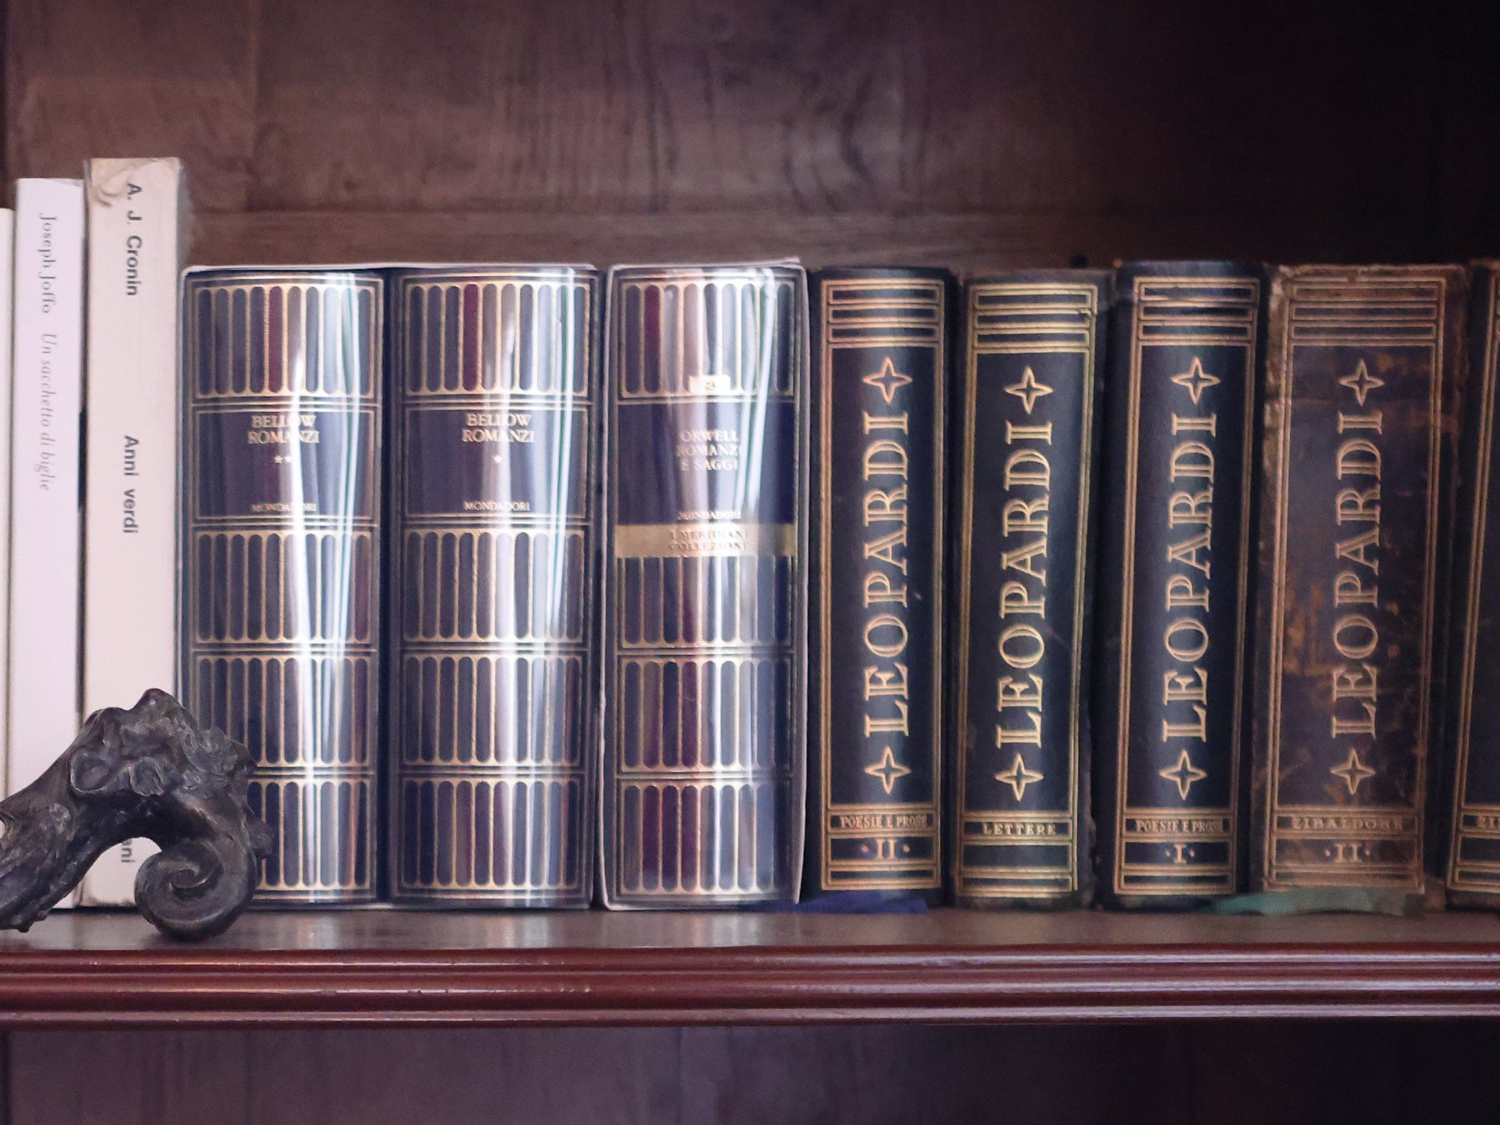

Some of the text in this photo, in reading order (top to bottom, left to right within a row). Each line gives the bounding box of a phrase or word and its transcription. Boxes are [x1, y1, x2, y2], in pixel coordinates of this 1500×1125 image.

[38, 212, 57, 270] Joseph
[127, 235, 143, 296] Cronin
[37, 272, 57, 315] Joffo
[40, 359, 57, 428] sacchetto
[251, 413, 317, 429] BELLW
[461, 429, 536, 444] ROMANZI
[466, 413, 533, 428] BELLOW
[124, 435, 140, 477] Anni
[123, 488, 139, 534] verdi
[464, 501, 531, 512] MONDADORI
[862, 410, 909, 738] LEOPARDI
[996, 420, 1053, 749] LEOPARDI
[1162, 411, 1217, 743] LEOPARDI
[1331, 410, 1383, 740] LEOPARDI
[982, 821, 1057, 836] LETTERE
